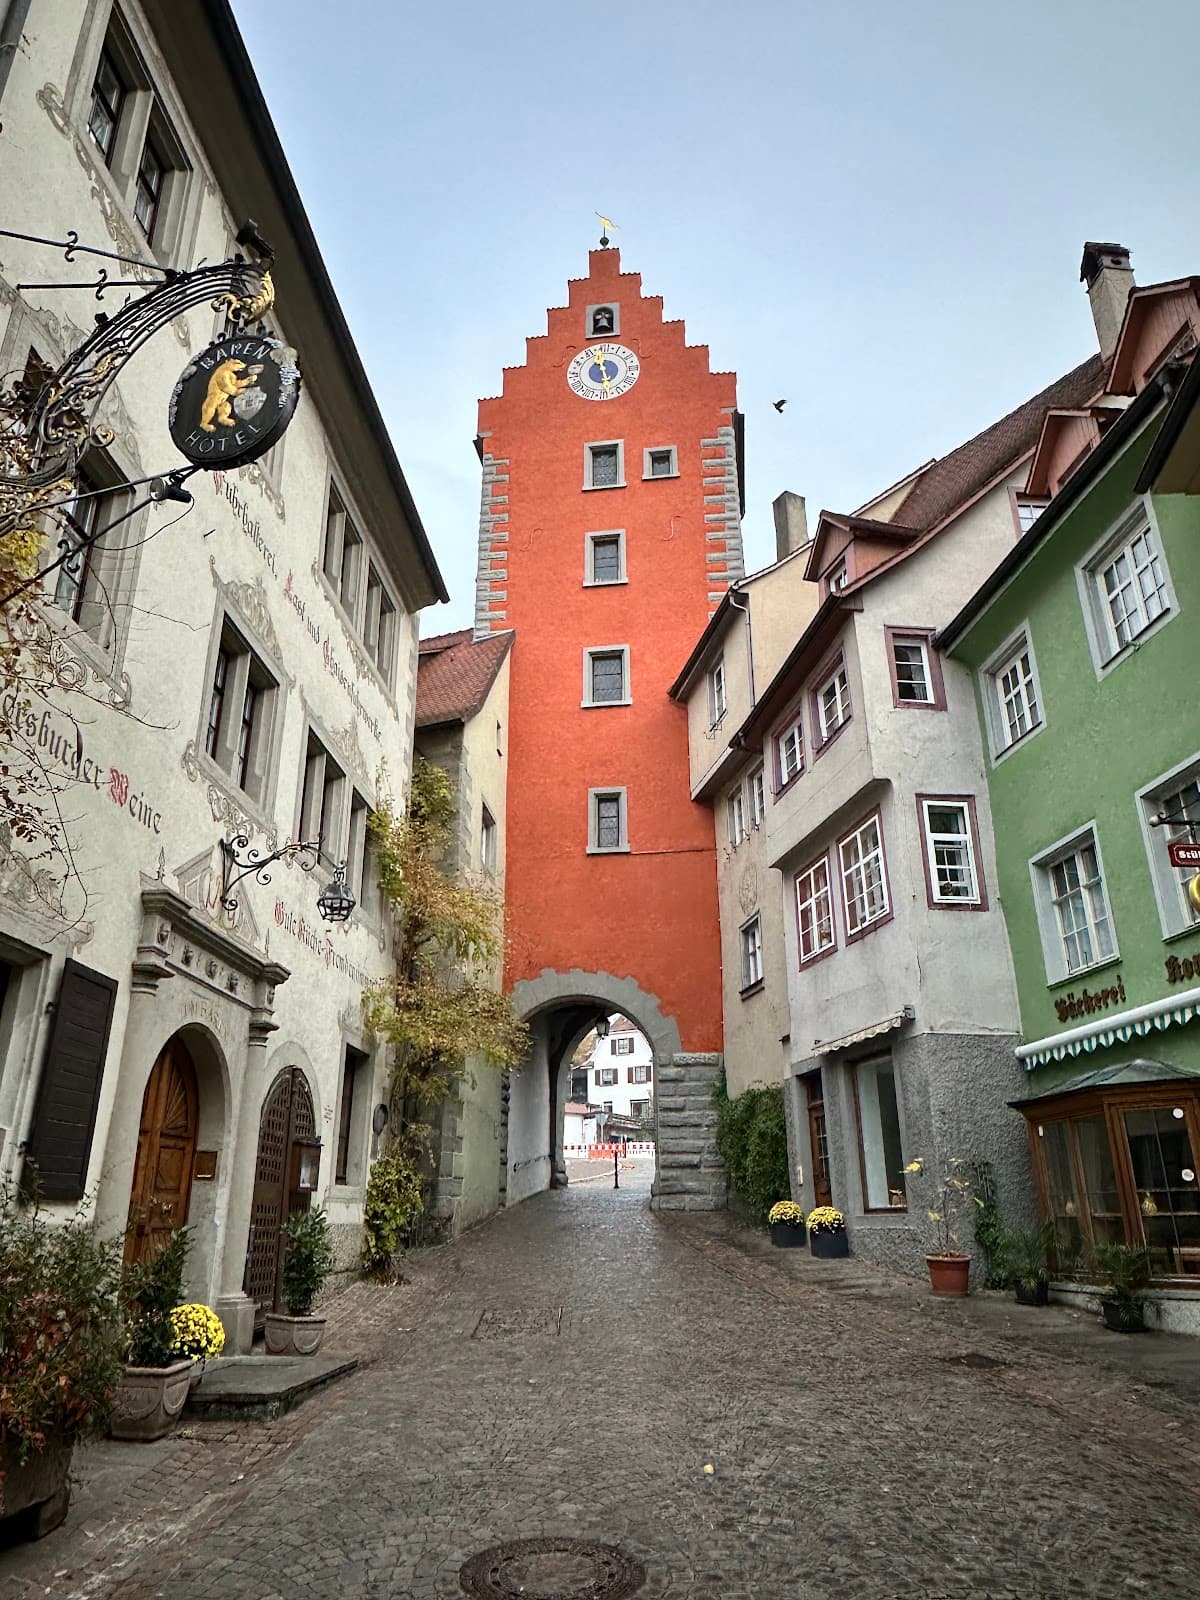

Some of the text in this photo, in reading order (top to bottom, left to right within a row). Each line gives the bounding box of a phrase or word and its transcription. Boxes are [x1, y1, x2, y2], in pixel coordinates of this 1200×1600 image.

[184, 424, 261, 454] HOTEL
[110, 767, 162, 834] Weine
[274, 900, 297, 936] Gute
[1054, 975, 1127, 1023] Bäckerei
